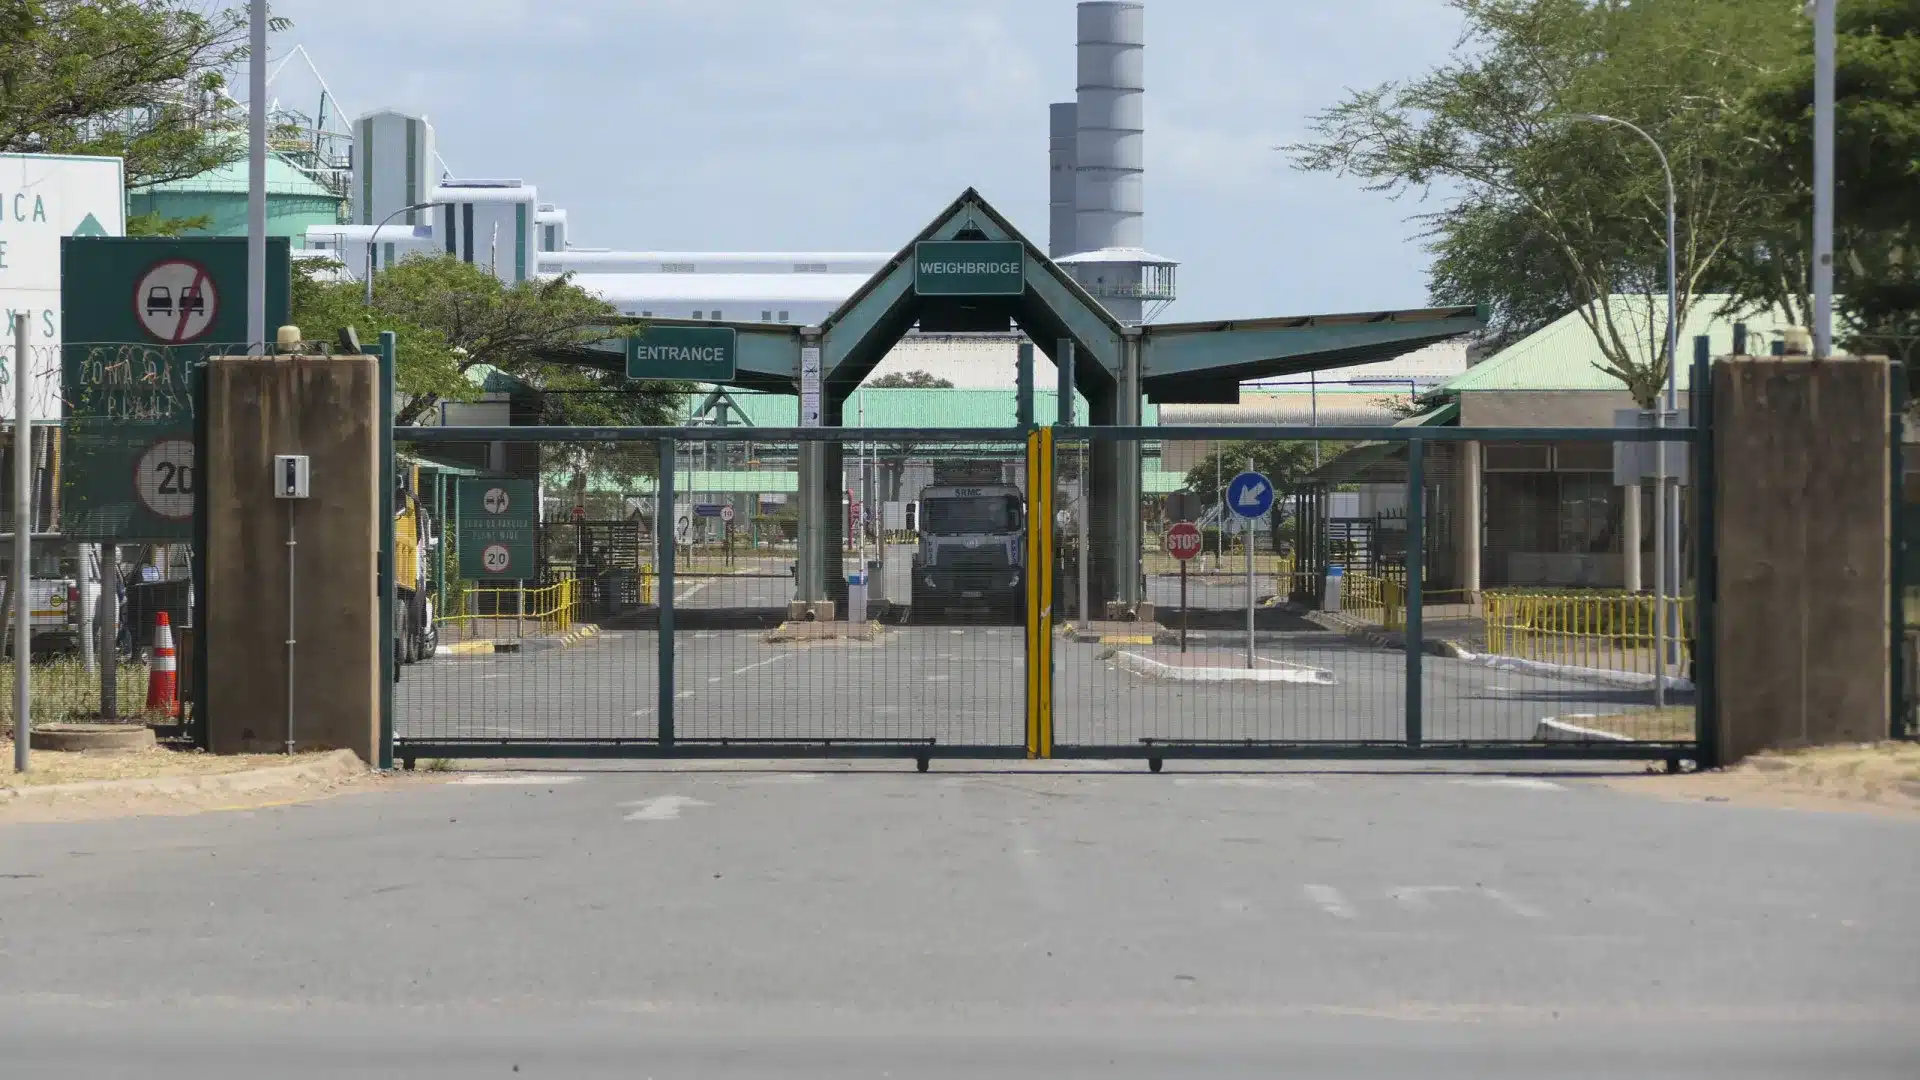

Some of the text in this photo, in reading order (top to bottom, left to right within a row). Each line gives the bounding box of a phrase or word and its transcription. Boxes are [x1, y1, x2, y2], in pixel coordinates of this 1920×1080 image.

[920, 262, 1020, 274] WEIGHBRIDGE
[637, 345, 724, 361] ENTRANCE
[1168, 534, 1200, 550] STOP
[488, 553, 506, 565] 20
